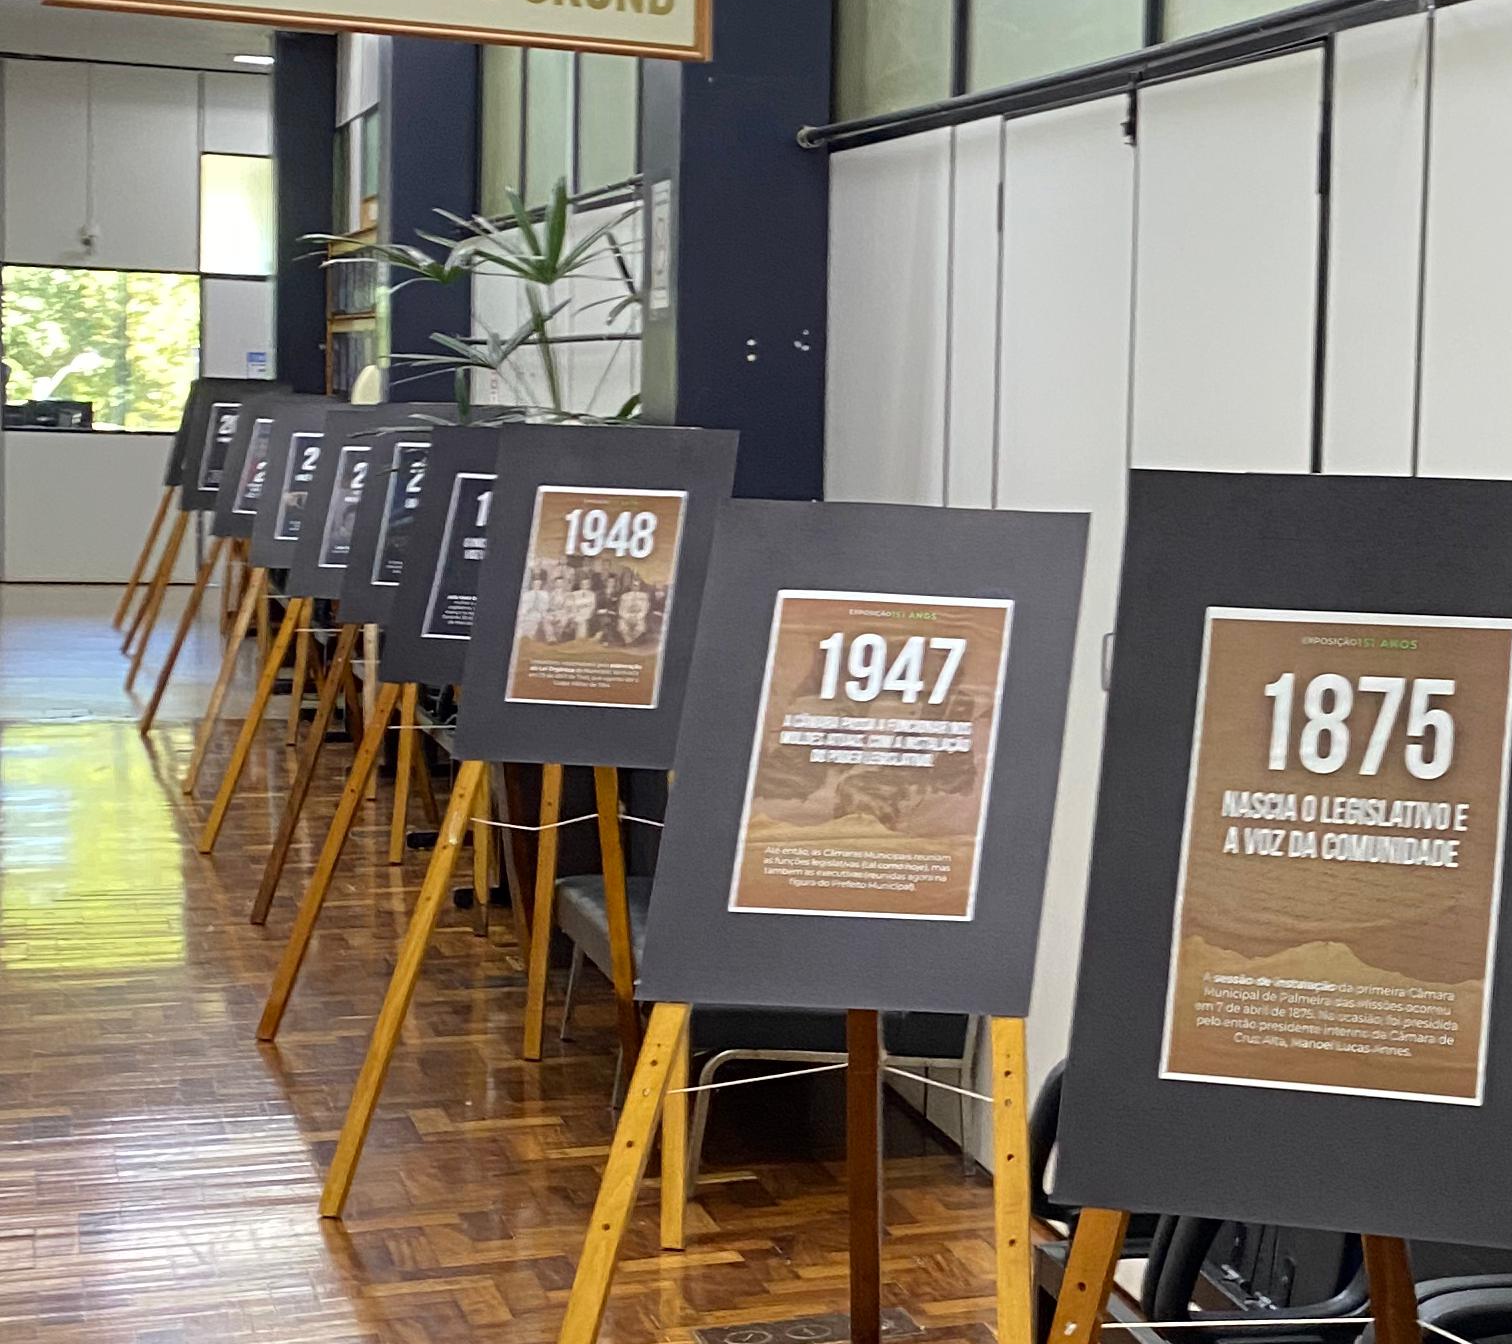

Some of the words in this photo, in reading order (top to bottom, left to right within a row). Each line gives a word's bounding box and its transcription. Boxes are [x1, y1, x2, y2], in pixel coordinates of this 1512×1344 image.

[565, 509, 657, 559] 1948
[1380, 638, 1418, 650] ANOS
[819, 632, 967, 705] 1947
[1264, 672, 1455, 780] 1875
[1222, 789, 1297, 821] NASCIA
[1301, 794, 1317, 822] O
[1320, 795, 1451, 830] LEGISLATIVO
[1453, 803, 1469, 831] E
[1223, 826, 1239, 854] A
[1244, 827, 1286, 856] VOZ
[1288, 830, 1318, 858] DA
[1321, 832, 1460, 868] COMUNIDADE
[1203, 986, 1260, 1001] Municipal
[1261, 991, 1278, 1002] de
[1279, 992, 1331, 1006] Palmeira
[1356, 983, 1405, 998] primeira
[1194, 1001, 1214, 1012] em
[1215, 1001, 1224, 1012] 7
[1225, 1002, 1241, 1014] de
[1270, 1006, 1286, 1017] de
[1196, 1015, 1222, 1028] pelo
[1223, 1018, 1257, 1030] então
[1259, 1020, 1321, 1035] presidente
[1439, 1034, 1455, 1046] de
